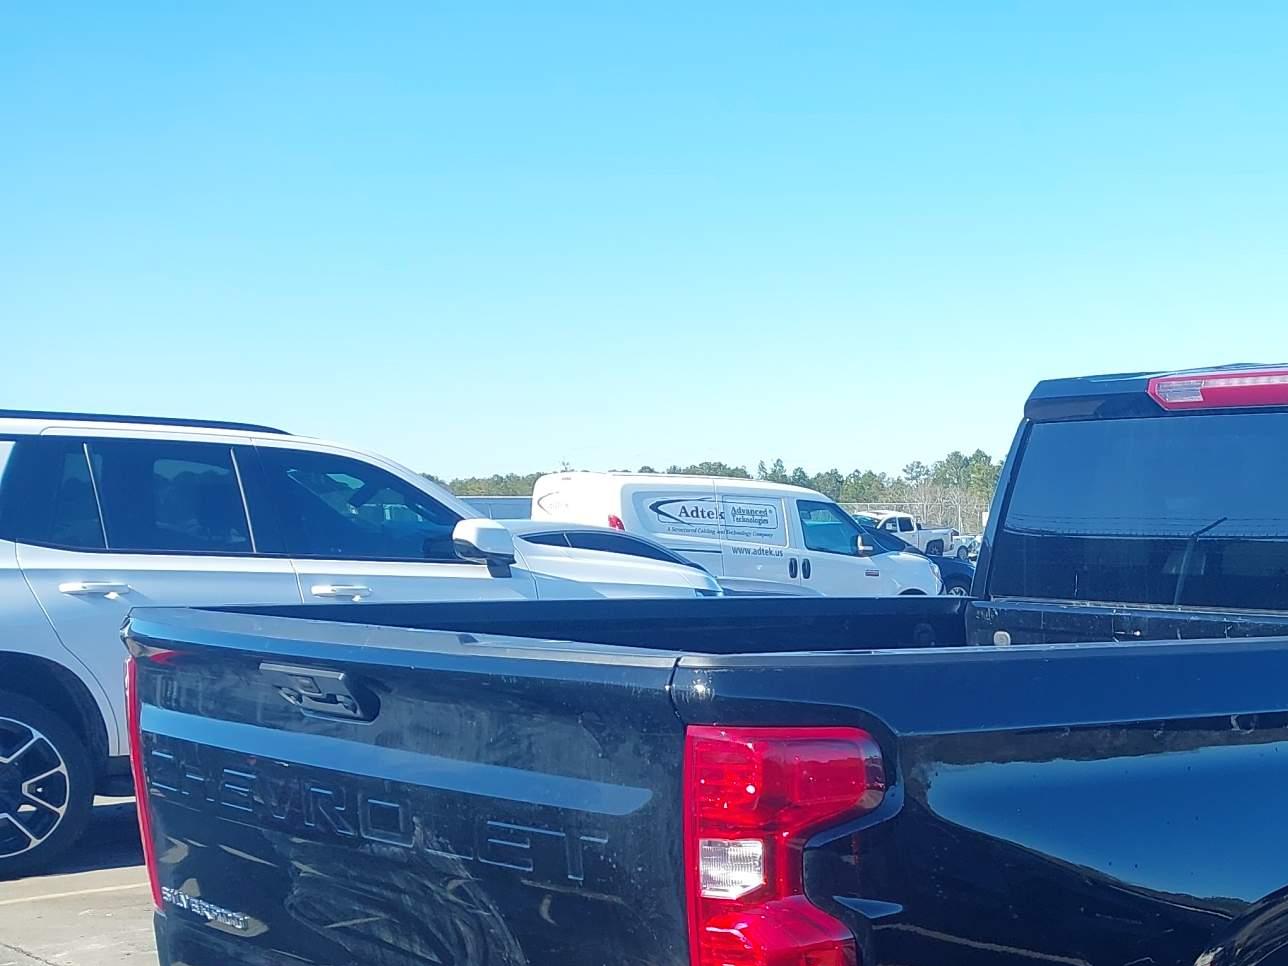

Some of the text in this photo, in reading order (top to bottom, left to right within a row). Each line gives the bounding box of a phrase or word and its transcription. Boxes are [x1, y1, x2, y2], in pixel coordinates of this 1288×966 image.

[678, 505, 725, 520] Adtek
[731, 506, 768, 517] Advanced
[732, 515, 769, 525] Technologies
[732, 546, 784, 557] www.adtek.us
[148, 747, 610, 881] CHEVROLET
[161, 886, 249, 931] SILVERADO
